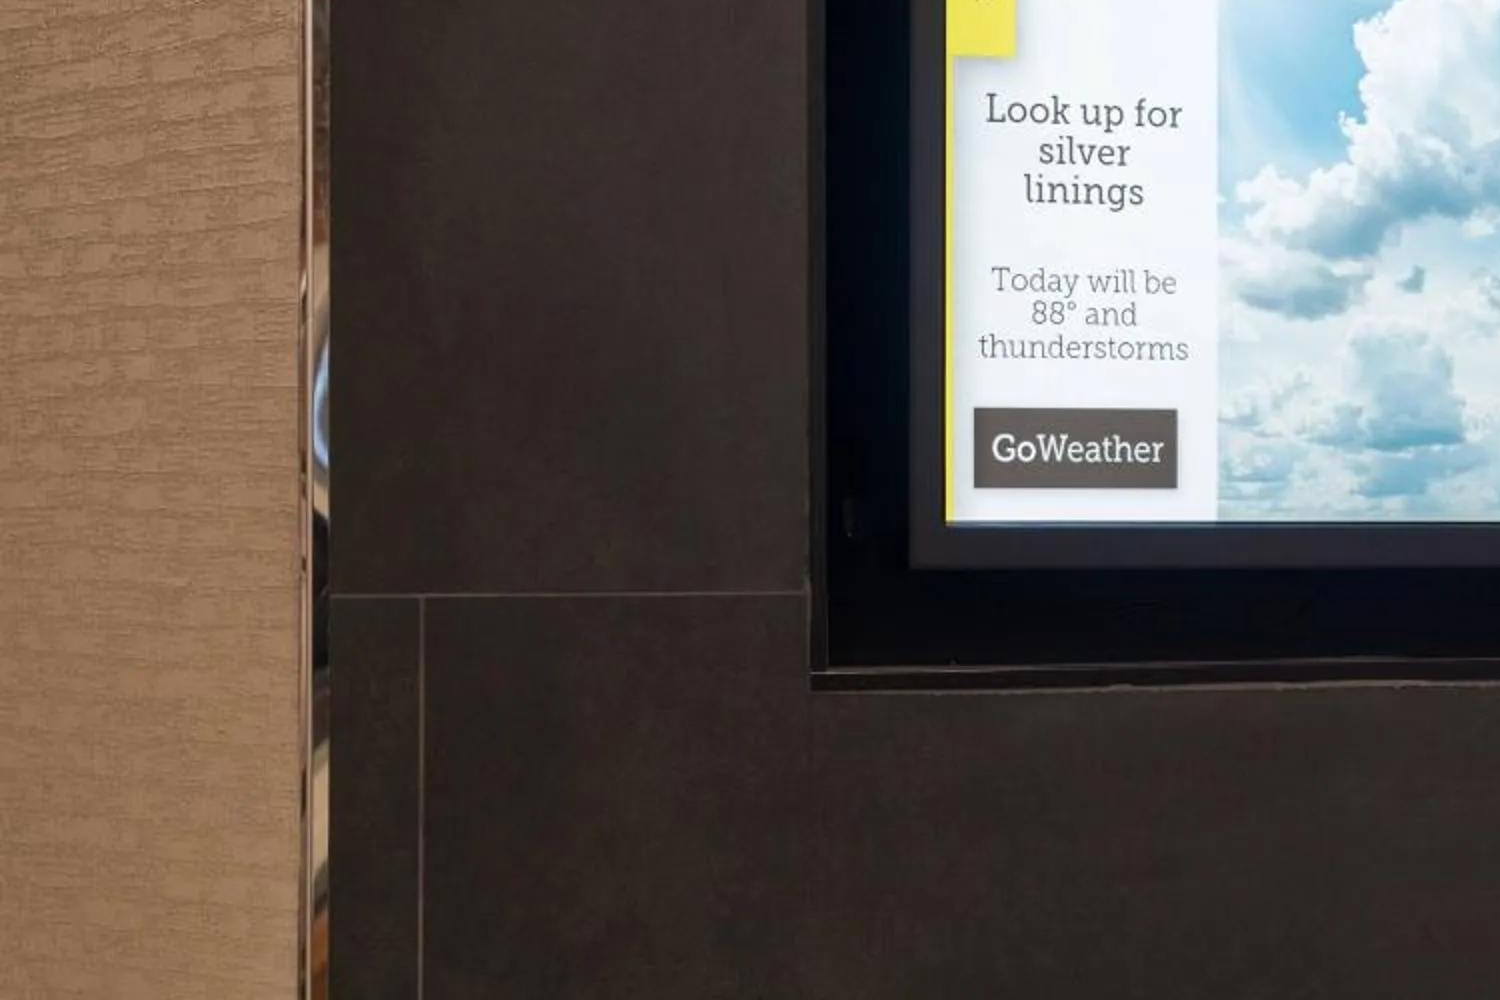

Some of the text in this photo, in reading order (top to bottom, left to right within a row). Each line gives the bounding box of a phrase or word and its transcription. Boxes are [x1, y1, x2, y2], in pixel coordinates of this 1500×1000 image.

[985, 92, 1183, 133] Look up for
[1038, 135, 1131, 167] silver
[1023, 173, 1145, 213] linings
[991, 266, 1177, 299] Today will be
[1030, 300, 1138, 327] 88° and
[978, 334, 1190, 362] thunderstorms
[991, 432, 1165, 465] GoWeather
